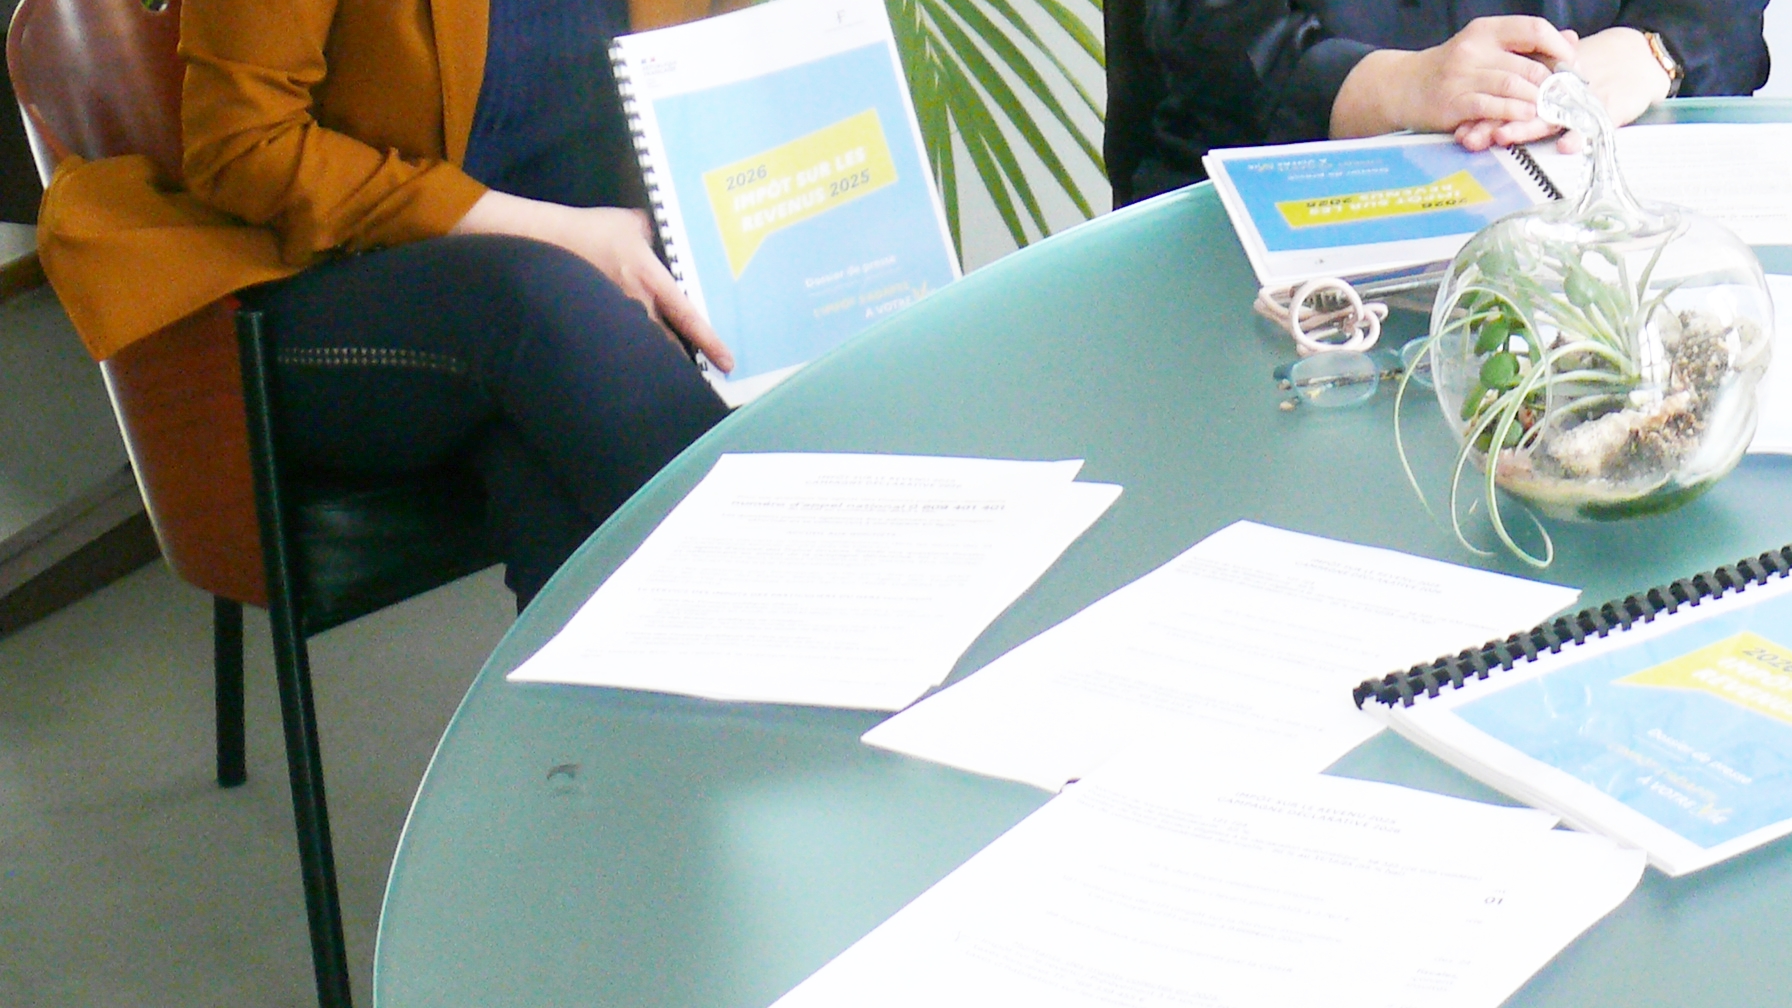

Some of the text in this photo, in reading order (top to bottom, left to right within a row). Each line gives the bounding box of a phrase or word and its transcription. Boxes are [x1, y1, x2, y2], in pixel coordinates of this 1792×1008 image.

[726, 164, 768, 191] 2026
[733, 145, 867, 212] IMPÔT SUR LES
[829, 168, 870, 197] 2025
